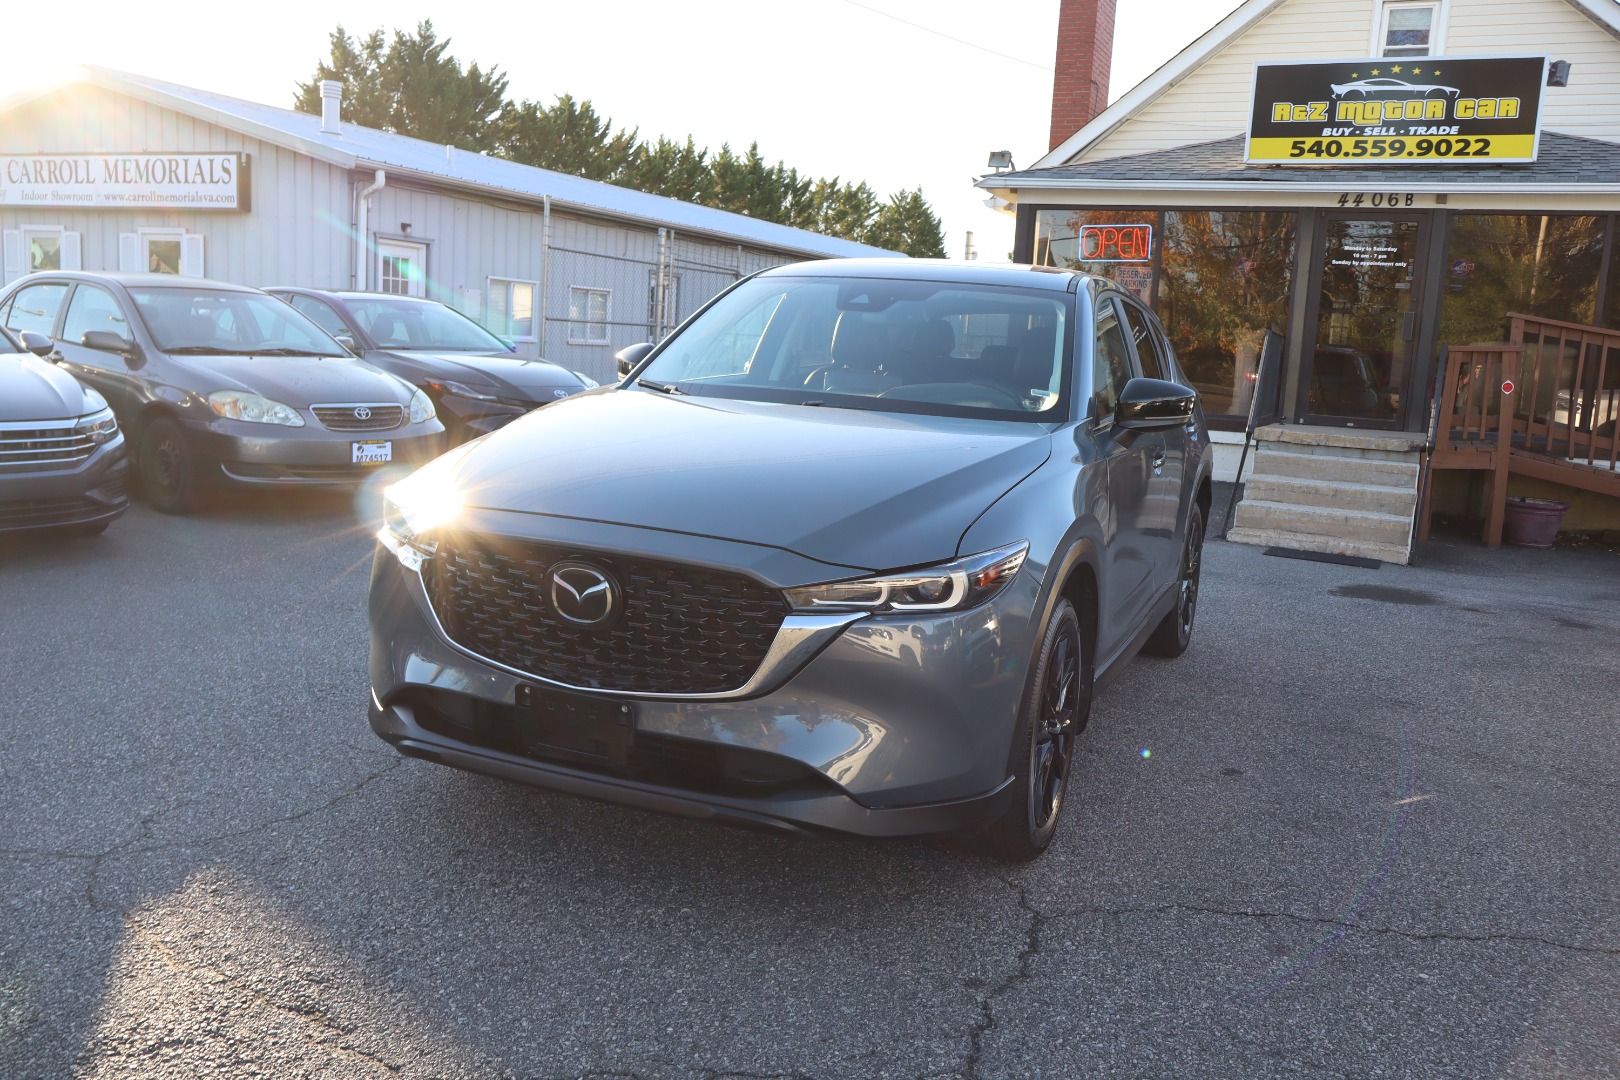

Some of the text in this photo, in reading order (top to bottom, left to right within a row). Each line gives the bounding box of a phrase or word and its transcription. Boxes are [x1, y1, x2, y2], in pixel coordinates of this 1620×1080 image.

[1321, 125, 1459, 136] BUY SELL TRADE
[1289, 138, 1491, 157] 540.559.9022
[7, 157, 232, 185] CARROLL MEMORIALS
[21, 189, 235, 203] Indoor Showroom www.carrollmemorialsva.com
[1082, 228, 1148, 258] OPEN
[1119, 270, 1152, 280] RESERVED
[1120, 279, 1147, 289] PARKING
